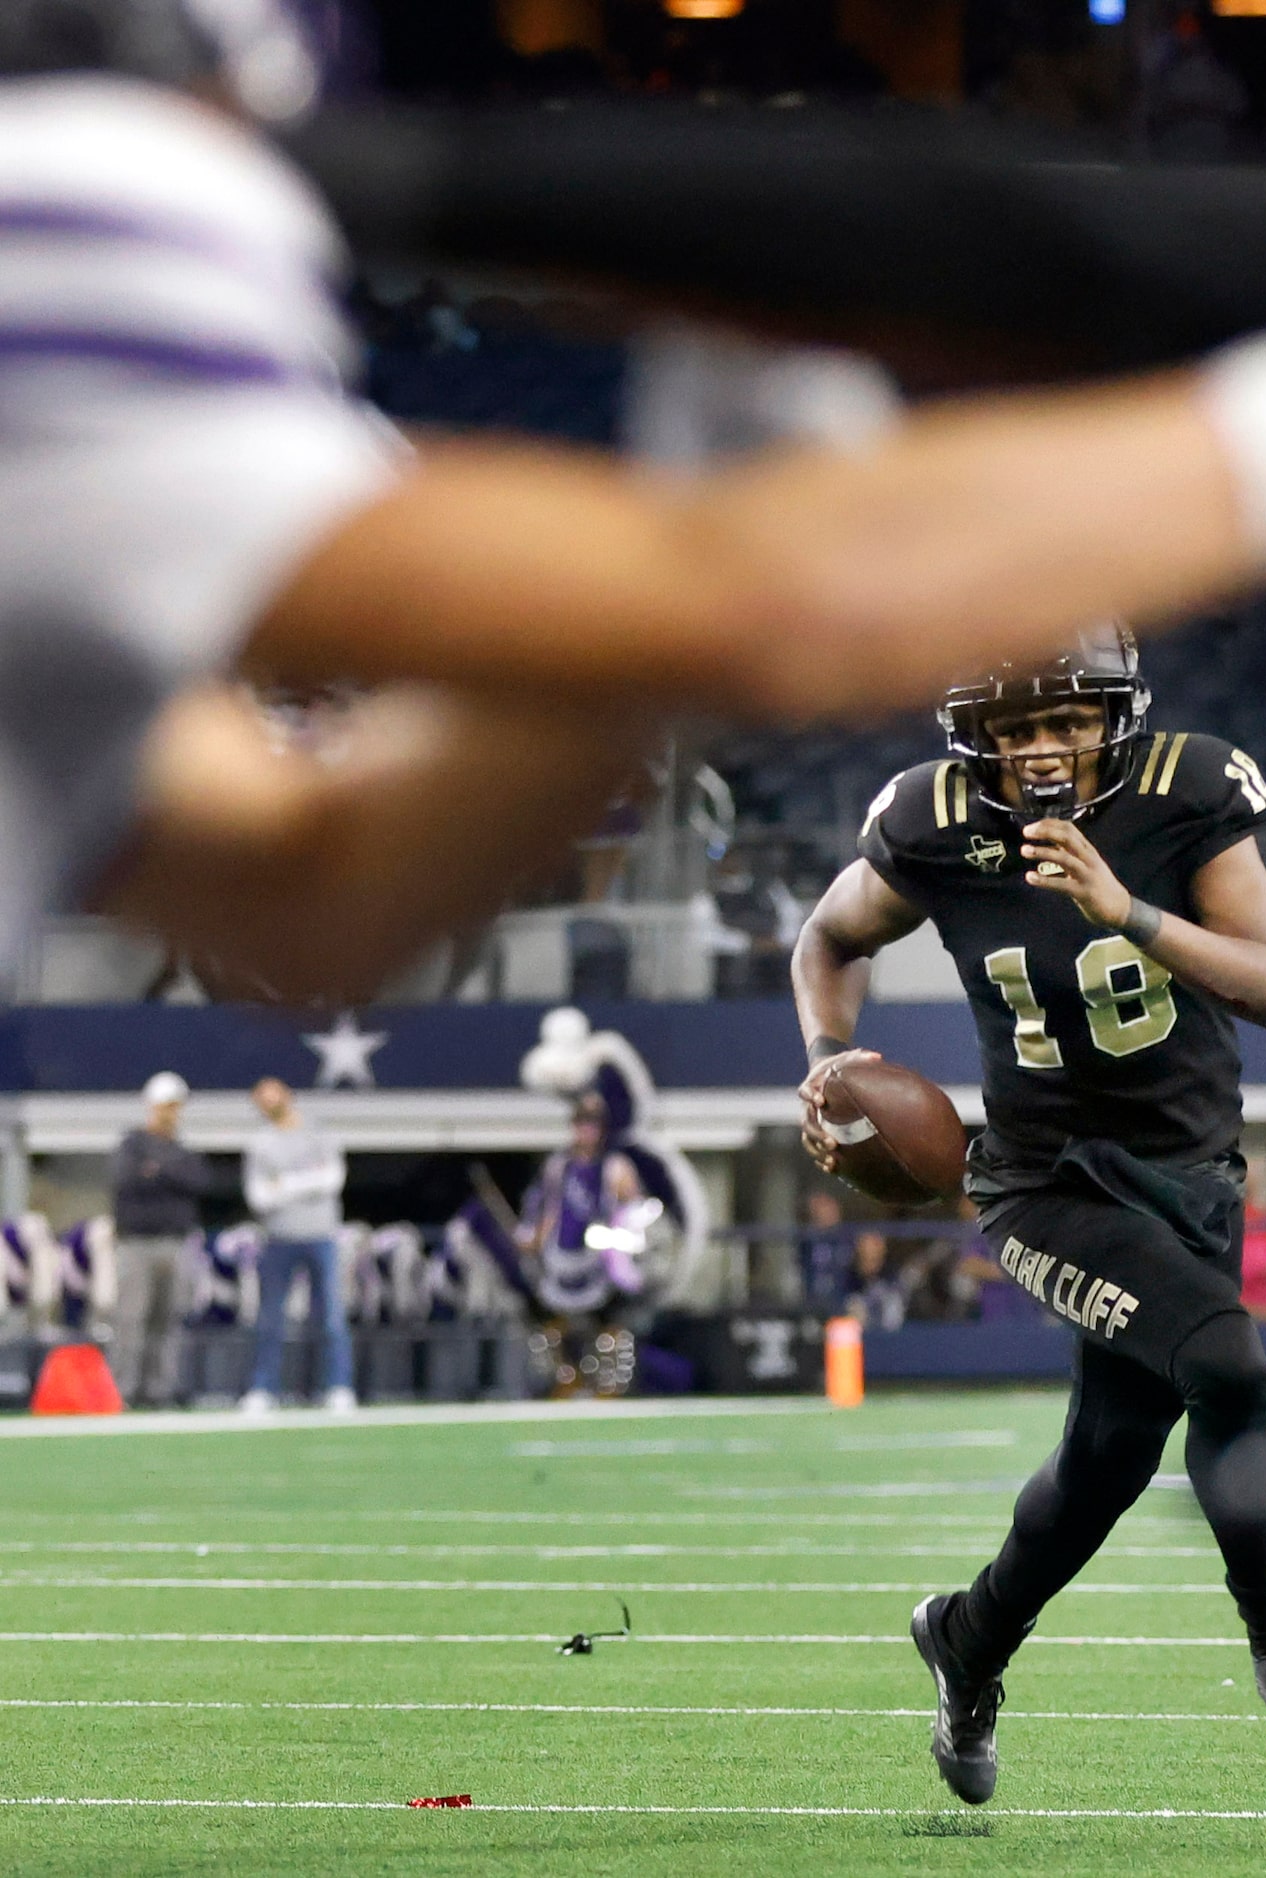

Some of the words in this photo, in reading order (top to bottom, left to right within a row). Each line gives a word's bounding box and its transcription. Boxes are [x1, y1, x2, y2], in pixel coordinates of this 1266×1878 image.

[983, 935, 1178, 1068] 18
[1000, 1235, 1056, 1302] OAK
[1053, 1262, 1140, 1339] CLIFF
